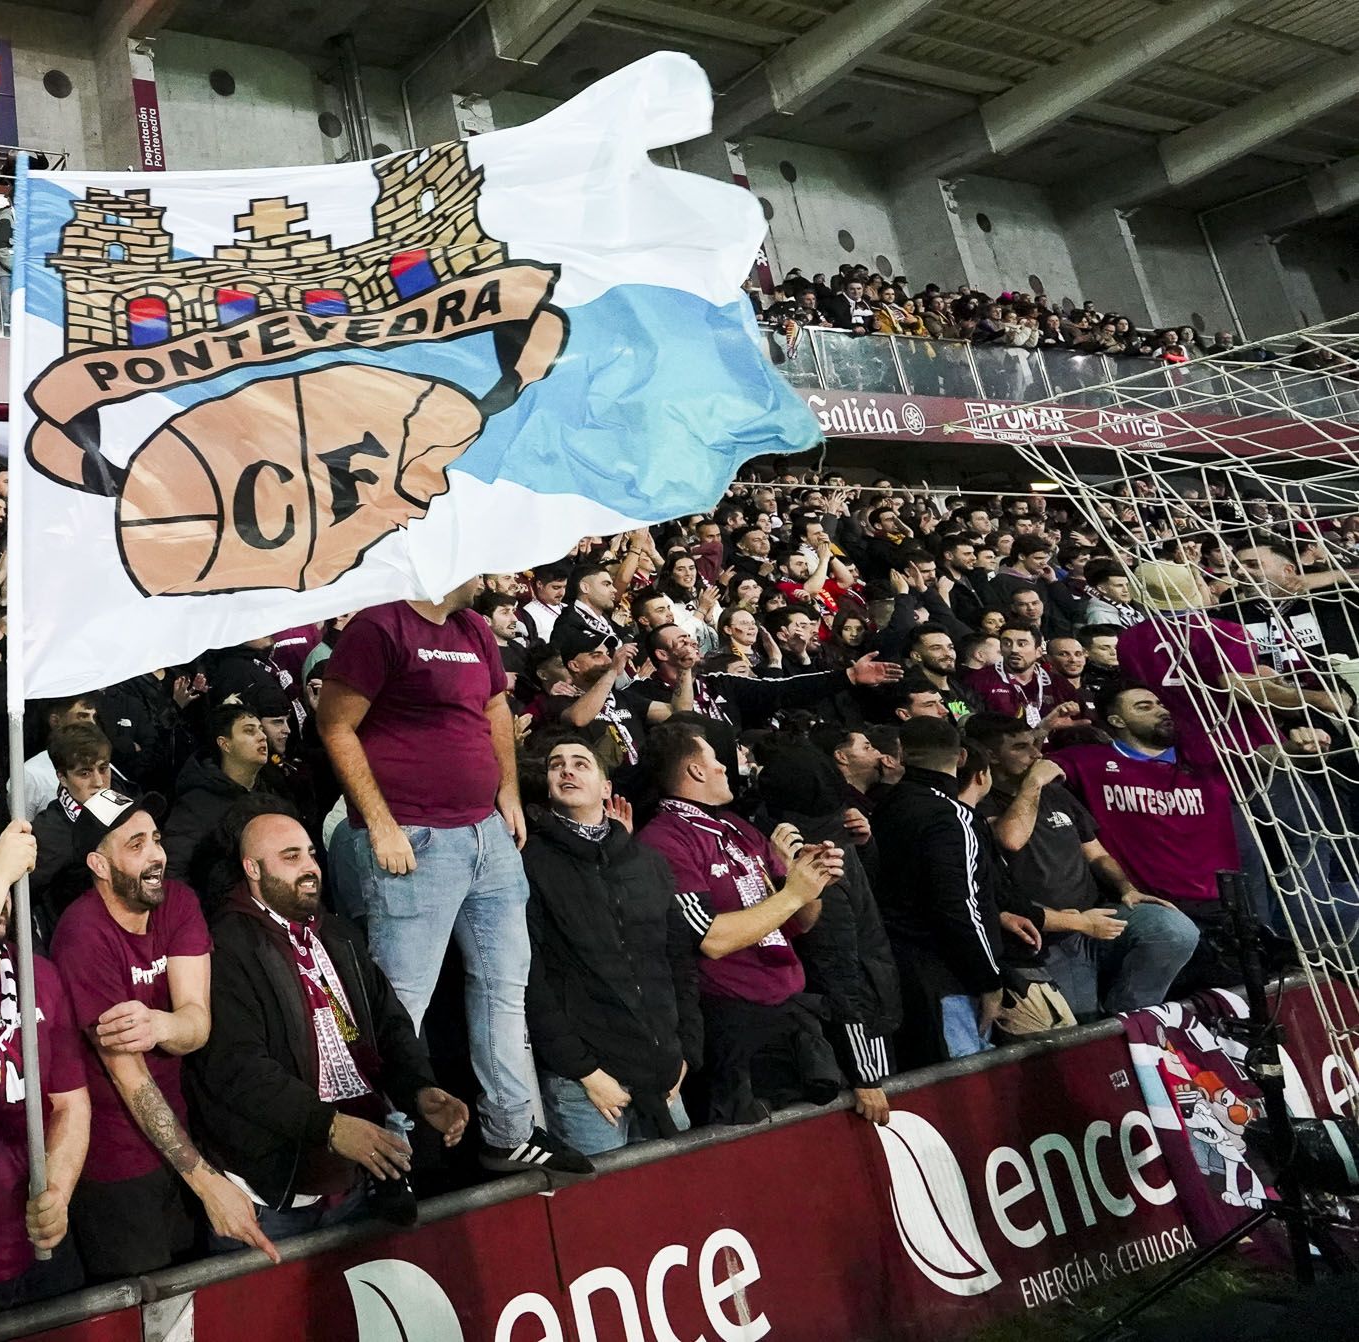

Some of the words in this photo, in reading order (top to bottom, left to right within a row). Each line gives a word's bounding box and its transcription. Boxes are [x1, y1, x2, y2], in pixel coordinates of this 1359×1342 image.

[138, 106, 154, 167] Deputación
[149, 108, 163, 168] Pontevedra
[84, 279, 503, 392] PONTEVEDRA
[807, 394, 899, 435] Galicia
[988, 403, 1070, 432] PUMAR
[1153, 641, 1185, 687] 2
[1102, 784, 1205, 816] PONTESPORT
[984, 1110, 1178, 1249] ence
[494, 1228, 772, 1342] ence
[1019, 1252, 1099, 1310] ENERGÍA
[1099, 1253, 1118, 1282] &
[1117, 1224, 1198, 1275] CELULOSA
